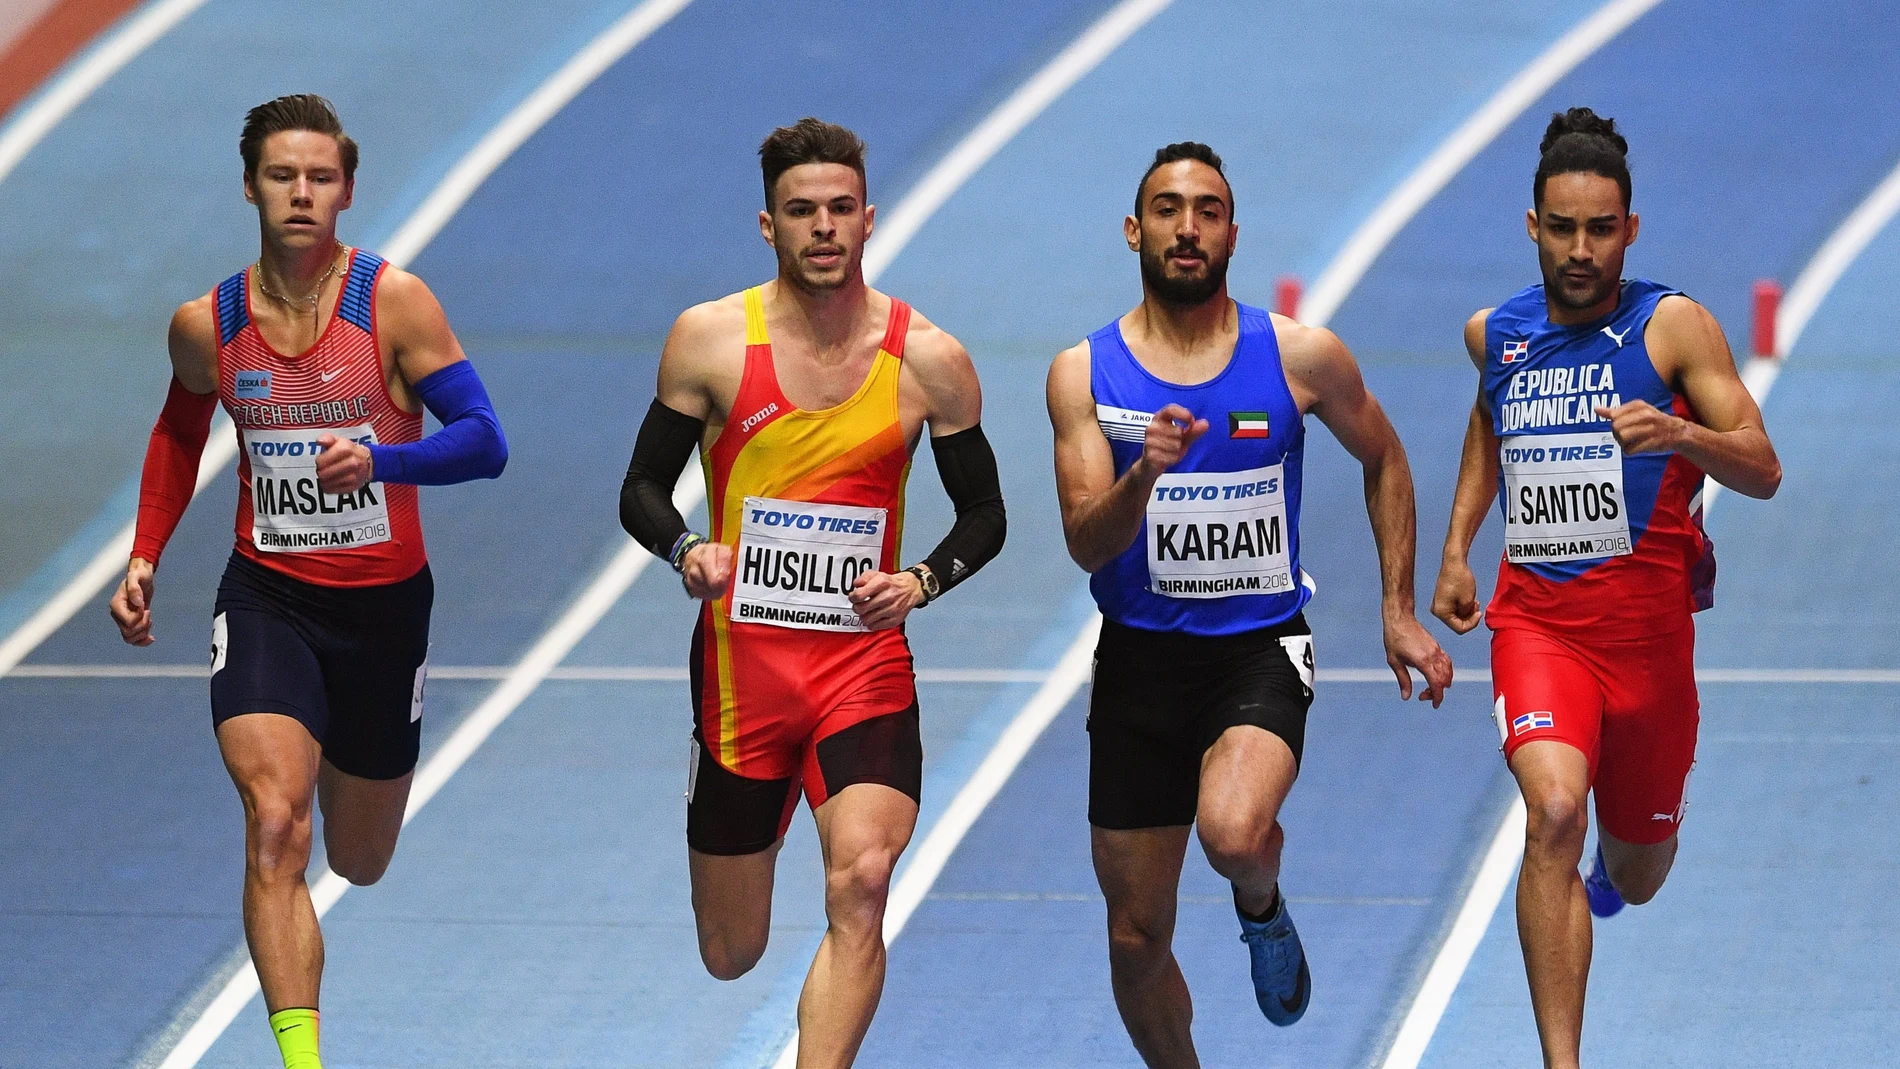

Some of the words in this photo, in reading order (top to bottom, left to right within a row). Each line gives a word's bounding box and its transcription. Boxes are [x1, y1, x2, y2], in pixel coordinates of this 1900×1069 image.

[233, 405, 283, 425] CZECH
[289, 396, 370, 424] REPUBLIC
[1130, 414, 1151, 422] JAKO
[251, 441, 305, 457] TOYO
[1505, 447, 1546, 463] TOYO
[1550, 444, 1614, 462] TIRES
[1156, 485, 1219, 502] TOYO
[1222, 477, 1279, 500] TIRES
[1520, 481, 1619, 525] SANTOS
[751, 509, 815, 530] TOYO
[817, 516, 880, 535] TIRES
[260, 530, 355, 547] BIRMINGHAM
[356, 523, 386, 541] 2018
[1156, 515, 1282, 562] KARAM
[1508, 540, 1594, 558] BIRMINGHAM
[1594, 537, 1627, 552] 2018
[1158, 576, 1261, 594] BIRMINGHAM
[1262, 572, 1288, 589] 2018
[739, 603, 842, 626] BIRMINGHAM
